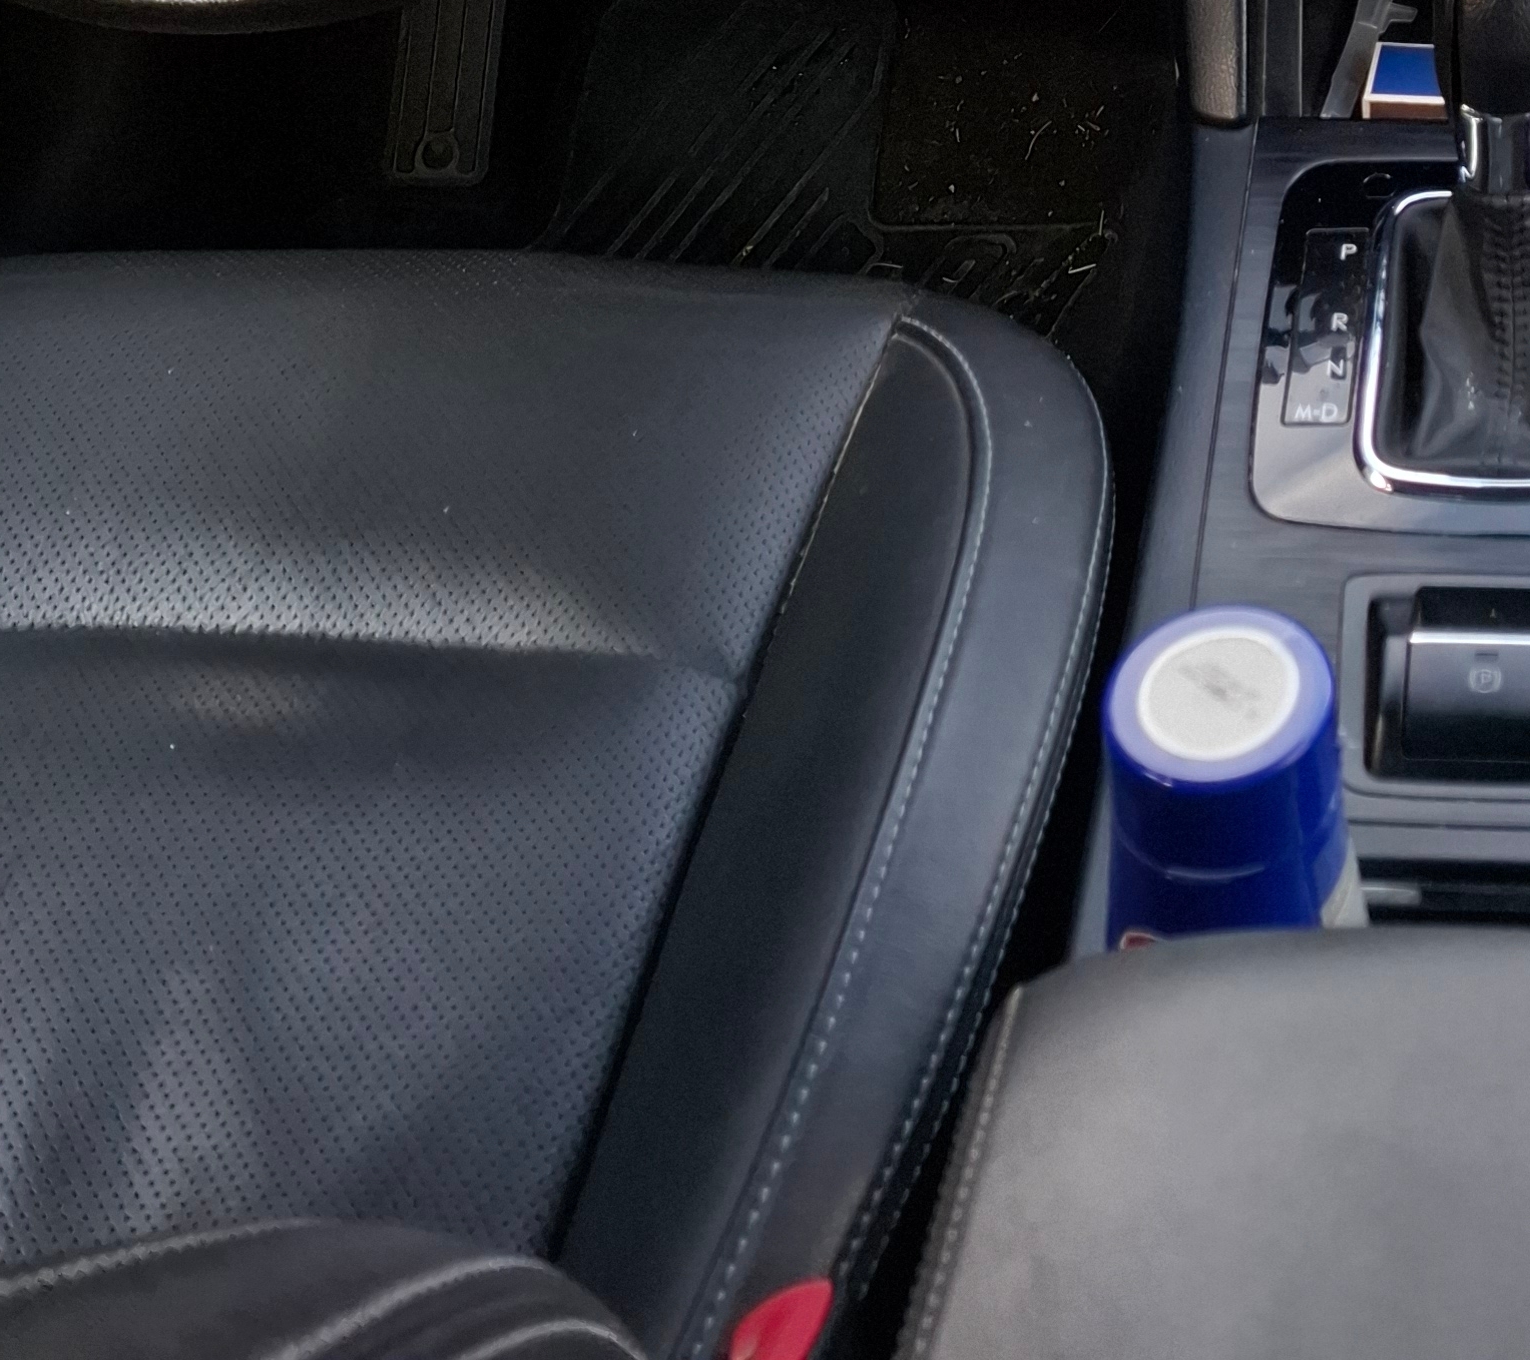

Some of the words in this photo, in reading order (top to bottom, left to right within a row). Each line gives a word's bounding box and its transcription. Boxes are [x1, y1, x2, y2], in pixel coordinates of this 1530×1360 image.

[1339, 243, 1358, 261] P
[1331, 312, 1349, 332] R
[1326, 359, 1344, 378] N
